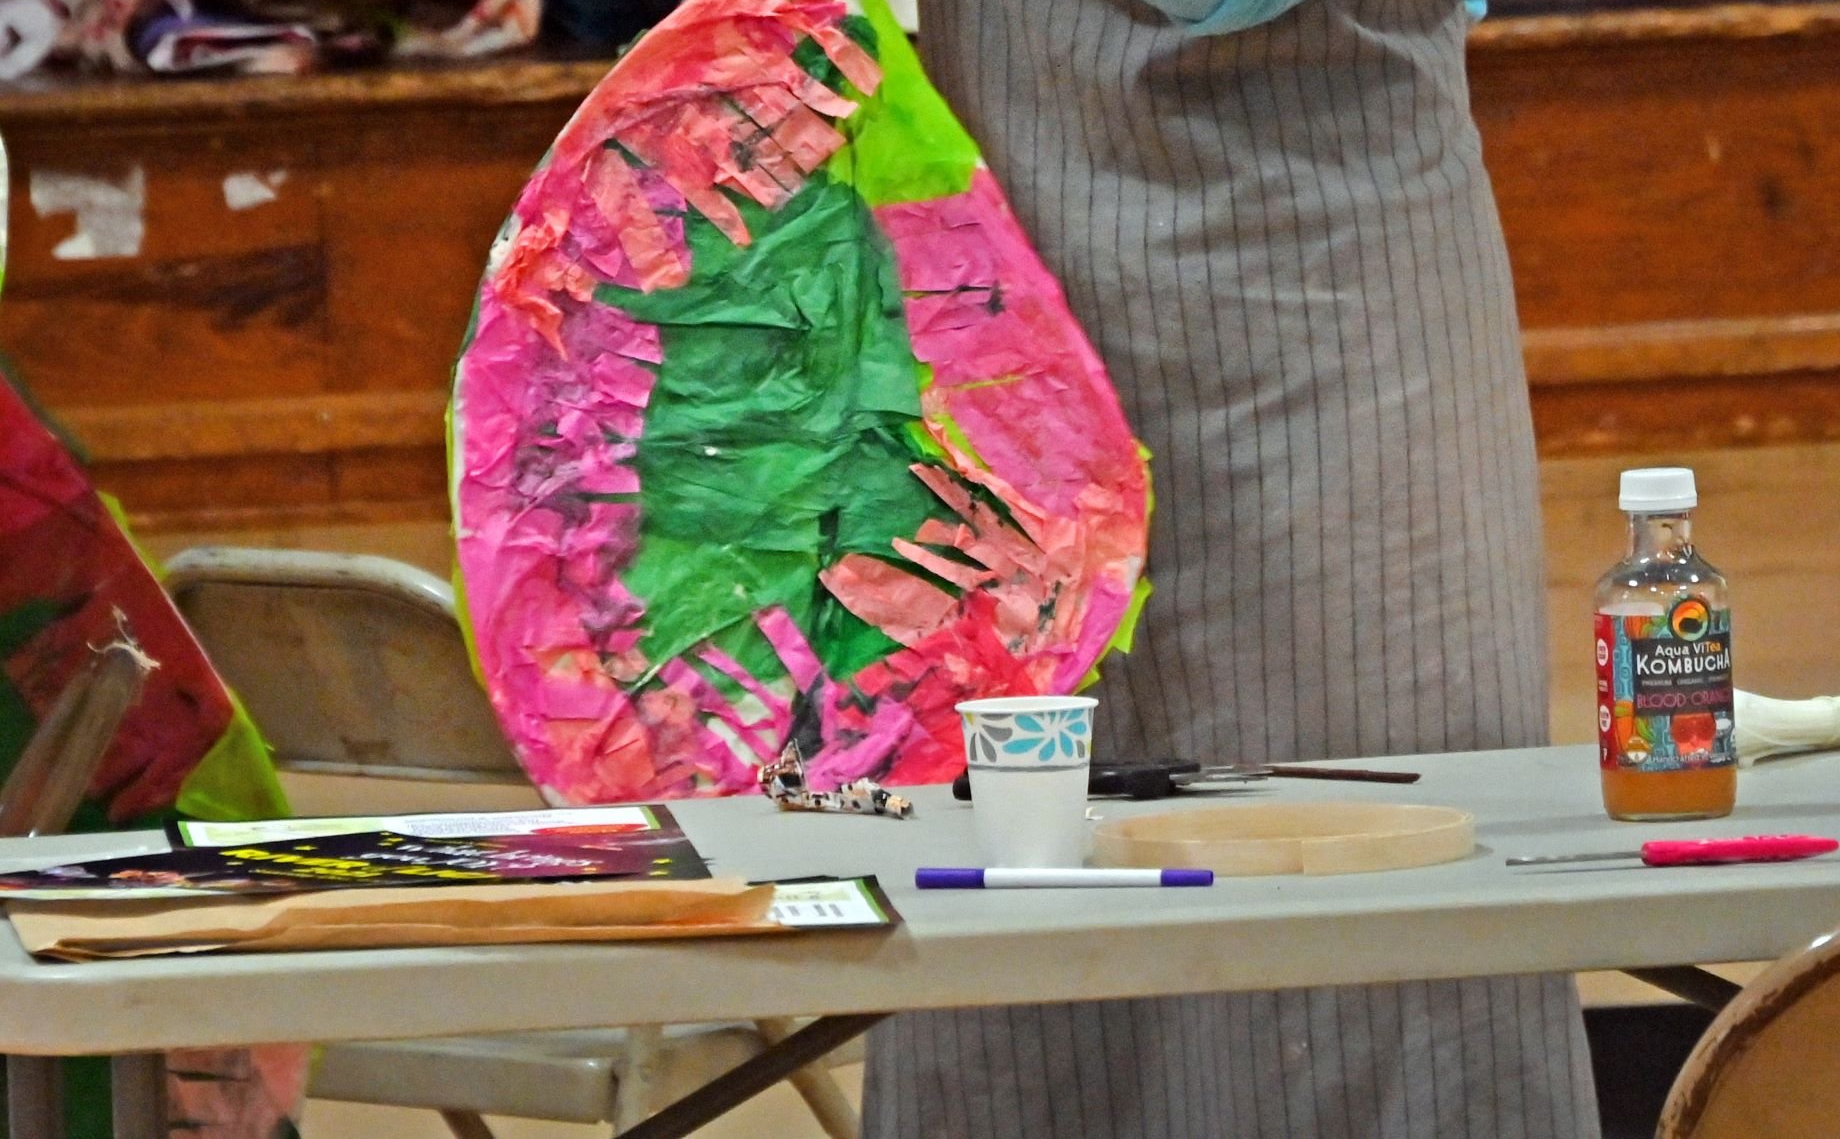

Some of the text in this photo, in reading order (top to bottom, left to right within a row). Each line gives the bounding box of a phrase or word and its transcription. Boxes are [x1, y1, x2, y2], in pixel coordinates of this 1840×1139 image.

[1655, 644, 1689, 658] Aqua
[1637, 648, 1730, 675] KOMBUCHA
[1636, 693, 1686, 708] BLOOD
